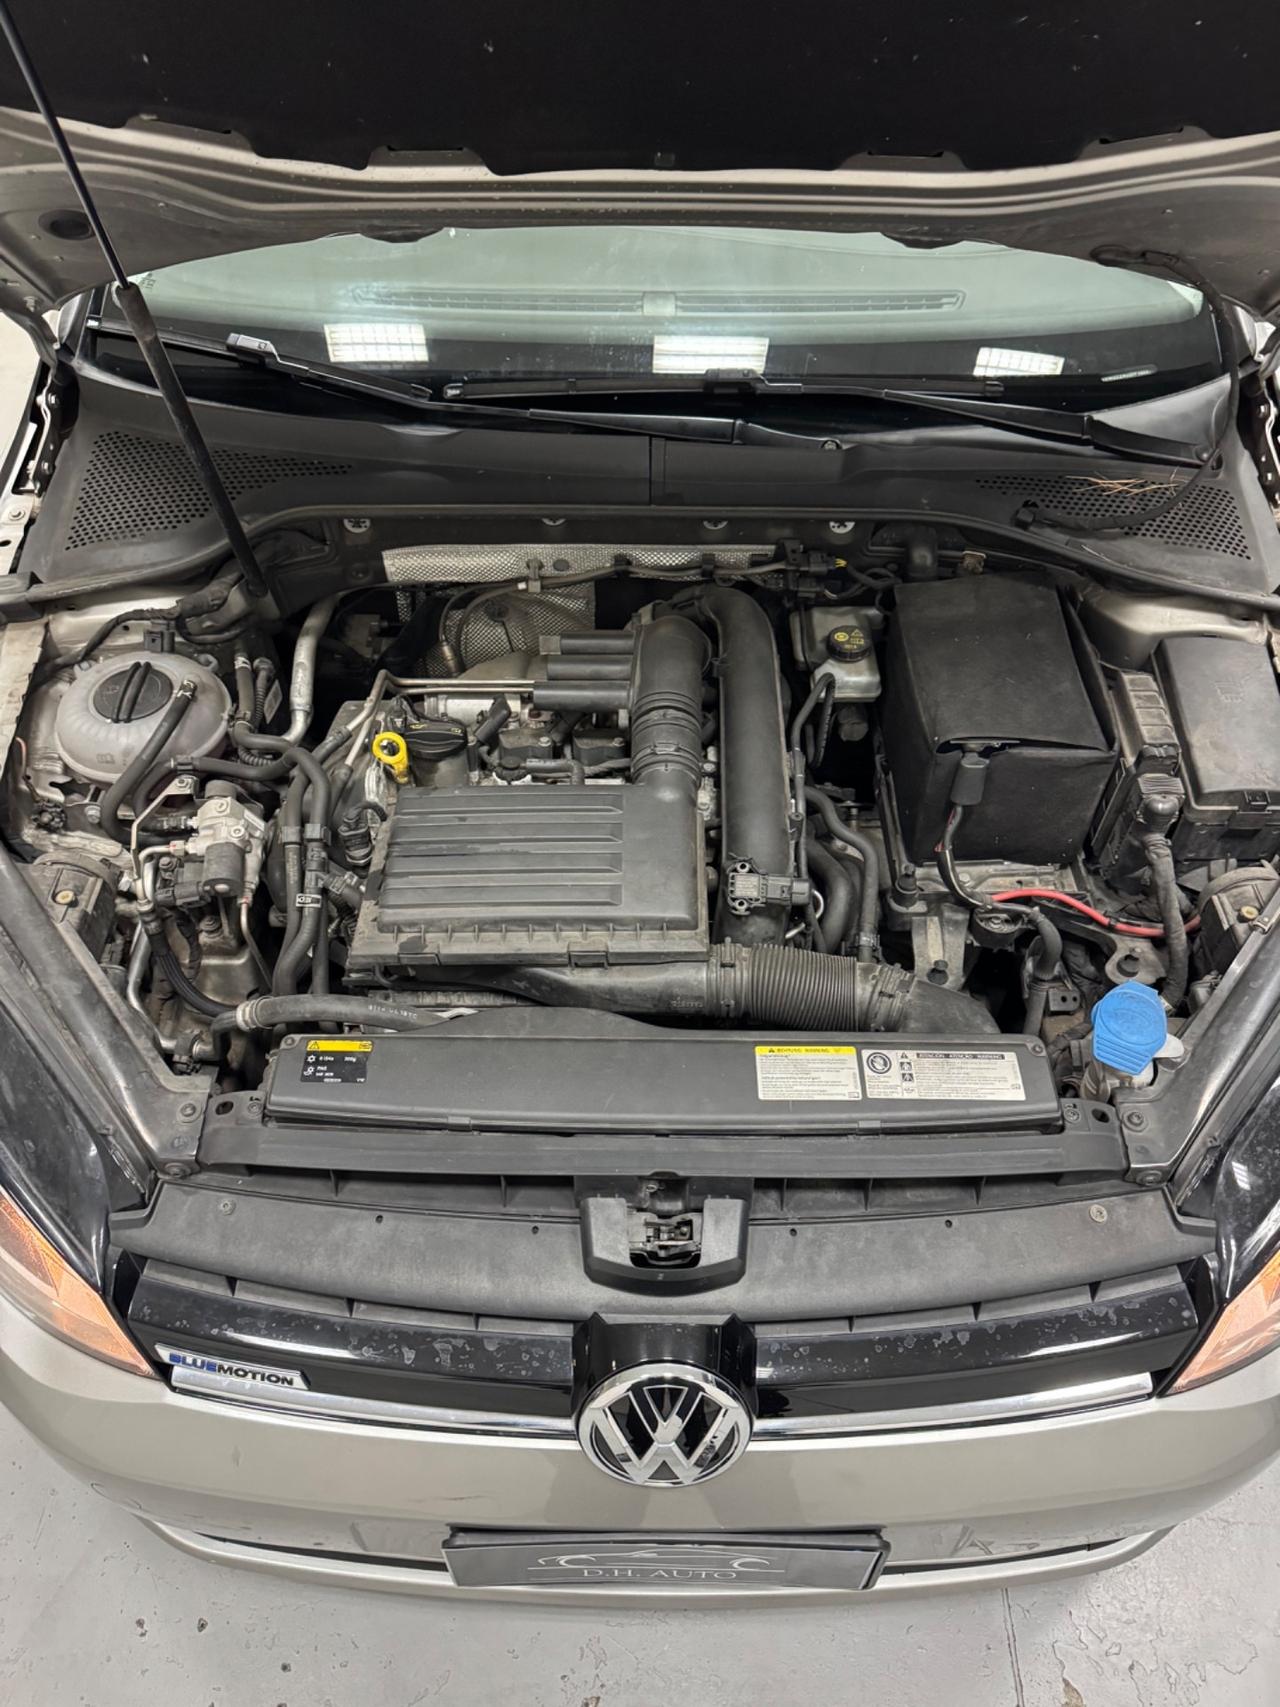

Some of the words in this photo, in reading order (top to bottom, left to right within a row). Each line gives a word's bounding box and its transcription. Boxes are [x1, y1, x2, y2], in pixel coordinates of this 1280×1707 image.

[169, 1352, 294, 1386] BLUEMOTION
[583, 1569, 641, 1577] D.H.
[650, 1569, 737, 1579] AUTO
